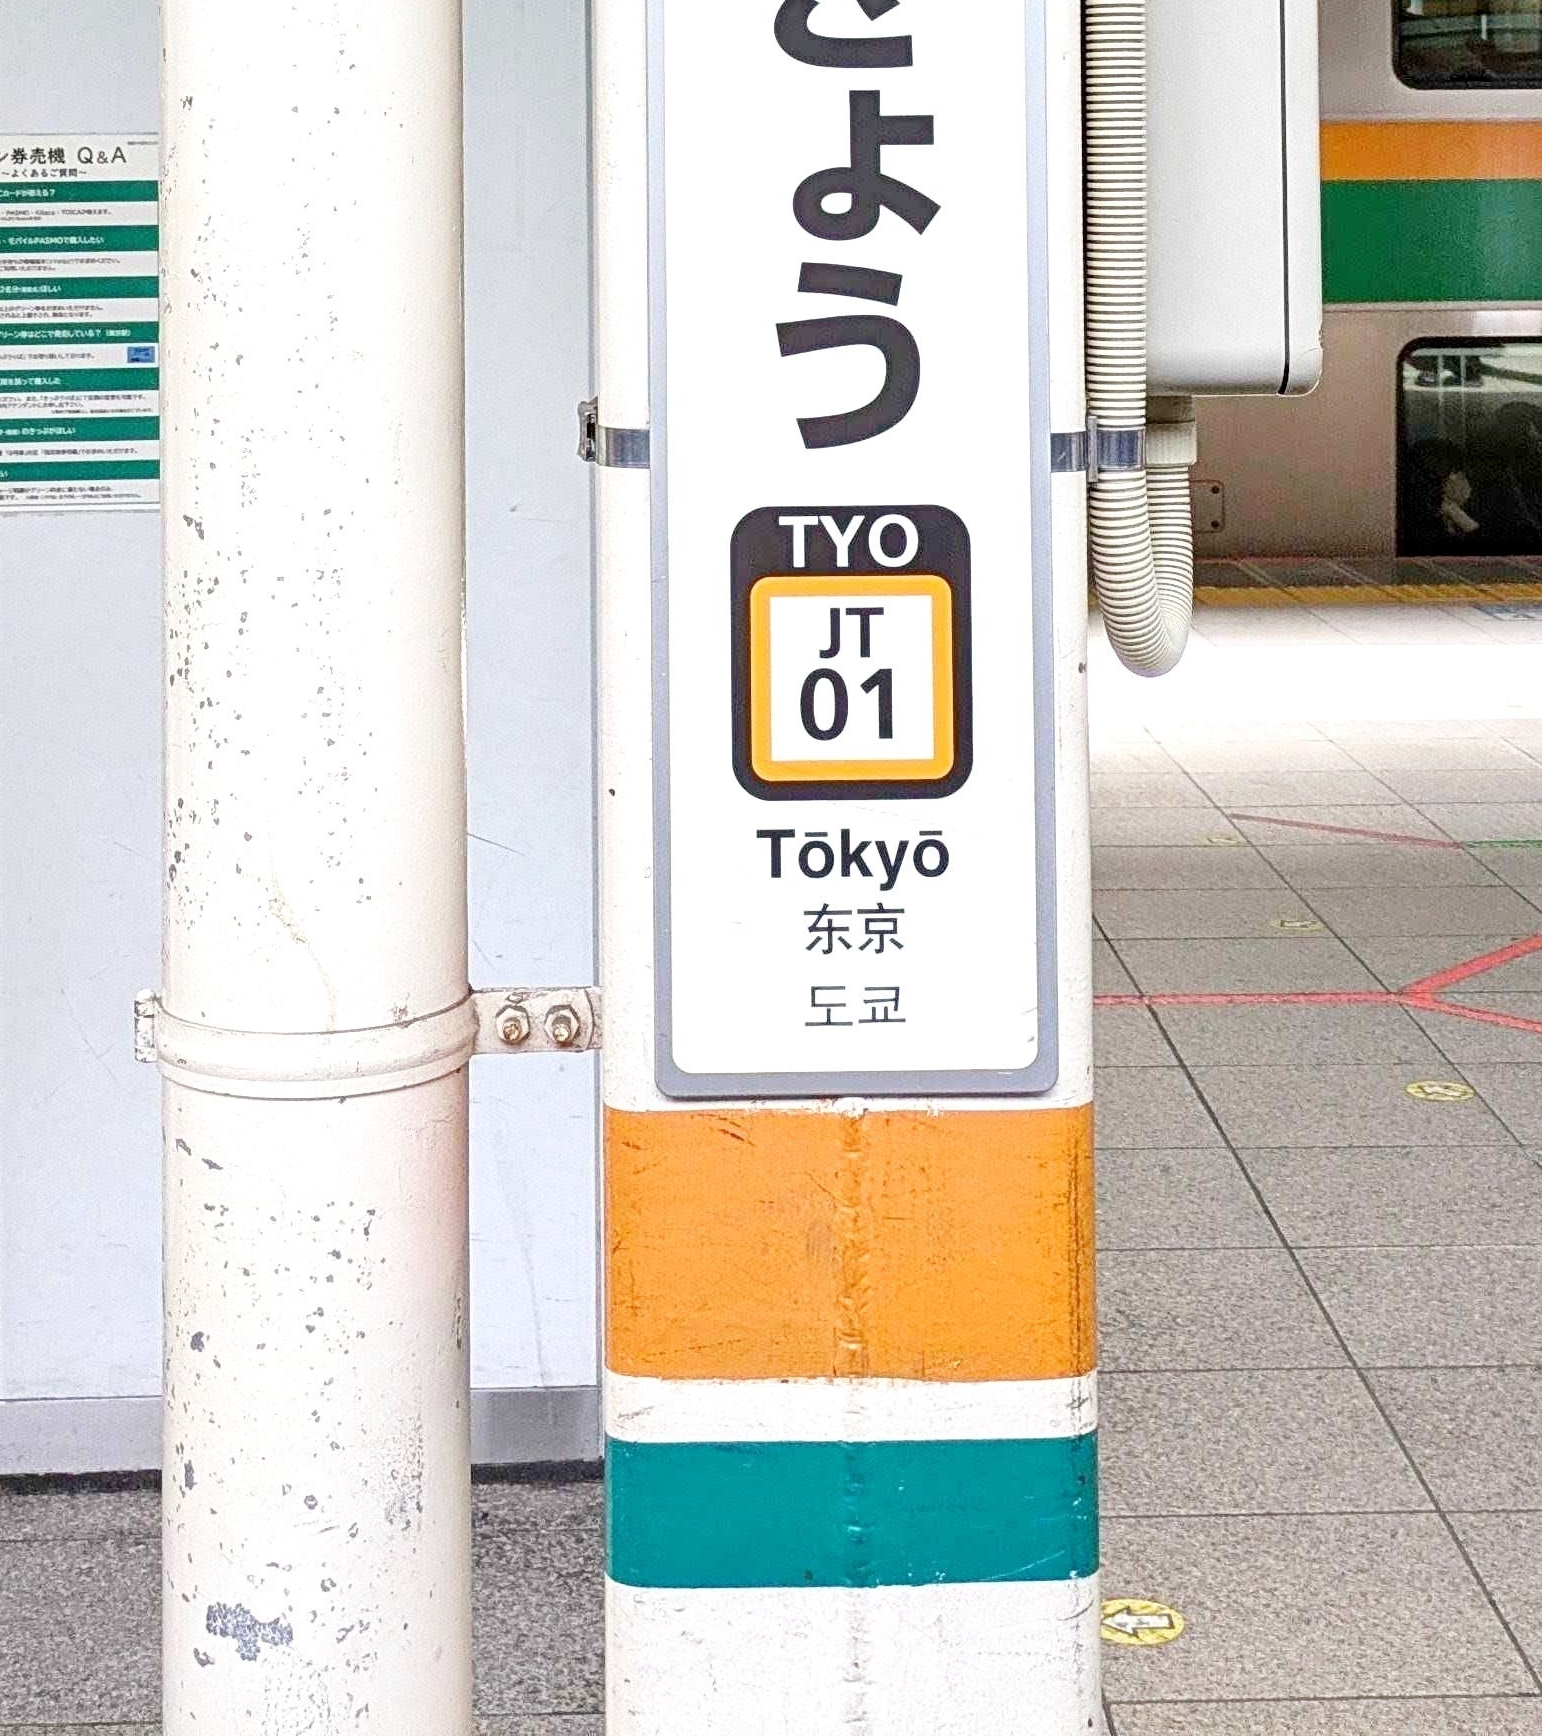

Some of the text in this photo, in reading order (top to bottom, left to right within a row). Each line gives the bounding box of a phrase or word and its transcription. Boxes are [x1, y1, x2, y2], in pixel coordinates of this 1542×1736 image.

[778, 514, 919, 569] TYO
[818, 607, 884, 658] JT
[799, 668, 893, 741] 01
[756, 828, 950, 892] Tōkyō
[802, 903, 905, 955] 东京
[804, 984, 907, 1028] 도쿄
